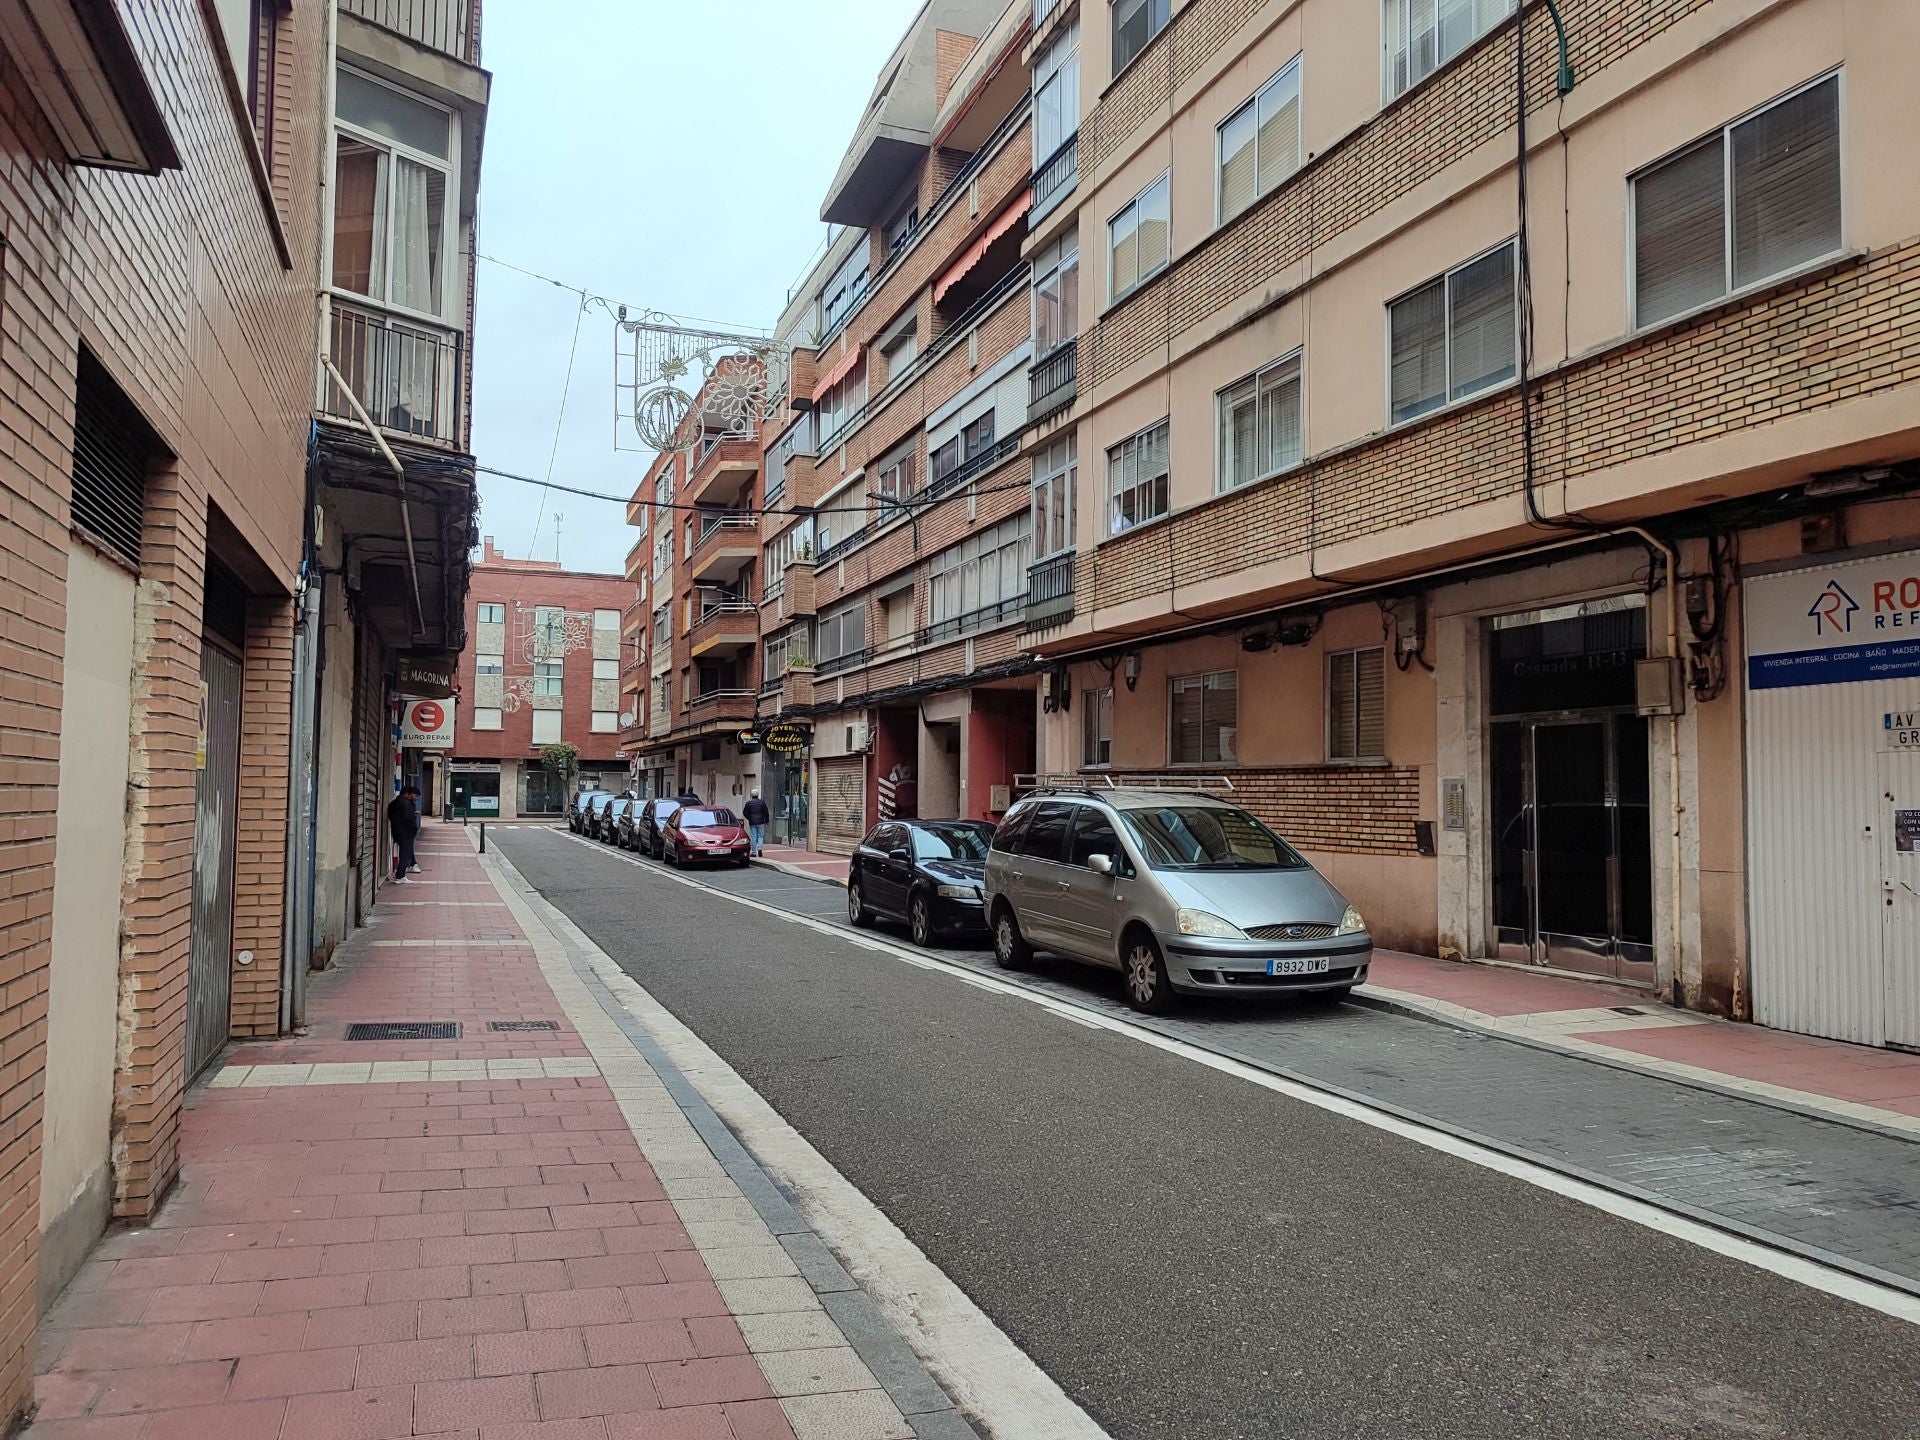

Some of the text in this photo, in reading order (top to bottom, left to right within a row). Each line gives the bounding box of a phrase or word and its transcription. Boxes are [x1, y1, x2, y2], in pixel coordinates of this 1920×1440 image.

[1875, 611, 1920, 629] REF
[1763, 658, 1794, 668] VIVIENDA
[1795, 655, 1829, 665] INTEGRAL
[1833, 651, 1860, 661] COCINA
[1865, 647, 1887, 658] BAÑO
[1514, 658, 1577, 676] Granada
[411, 670, 449, 687] MACORINA
[403, 733, 425, 741] EURO
[767, 732, 803, 743] Emilio
[1276, 959, 1327, 973] 8932 DWG
